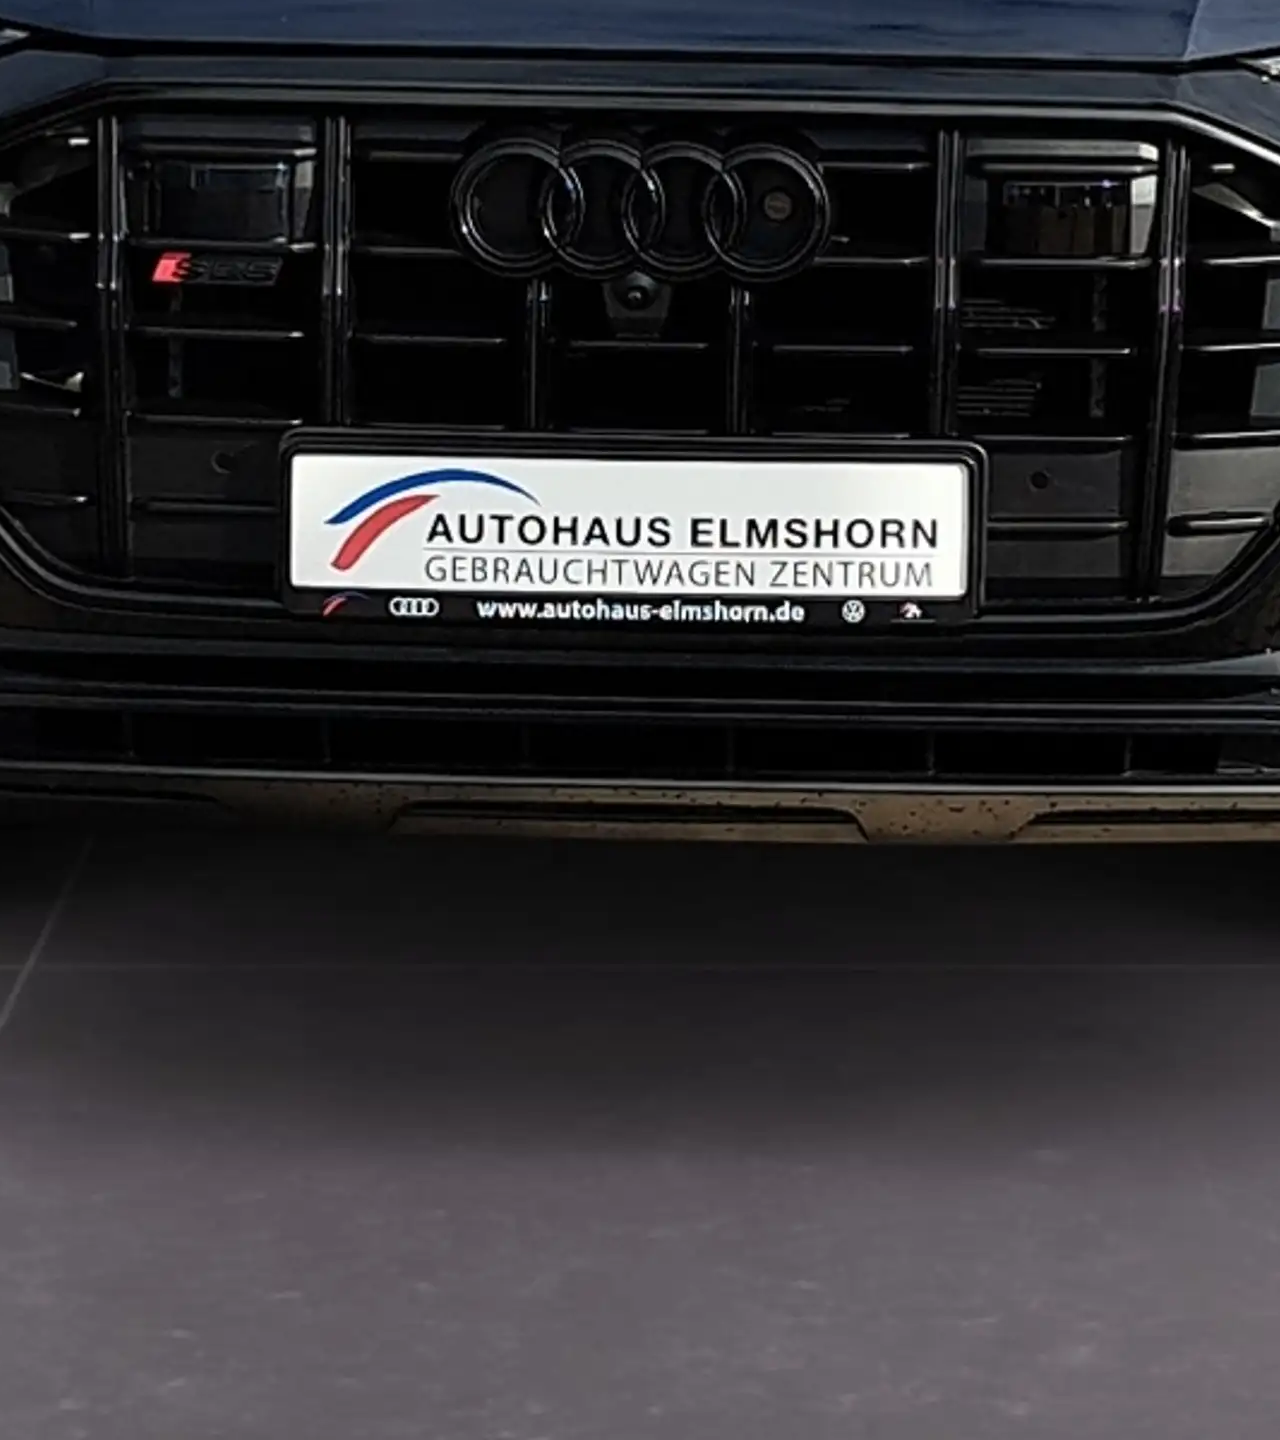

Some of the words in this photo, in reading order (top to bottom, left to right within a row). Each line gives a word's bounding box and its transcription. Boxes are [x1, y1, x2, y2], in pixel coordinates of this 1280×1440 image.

[427, 513, 671, 547] AUTOHAUS
[689, 517, 938, 550] ELMSHORN
[424, 555, 756, 588] GEBRAUCHTWAGEN
[769, 560, 933, 588] ZENTRUM
[476, 597, 806, 623] www.autohaus-elmshorn.de
